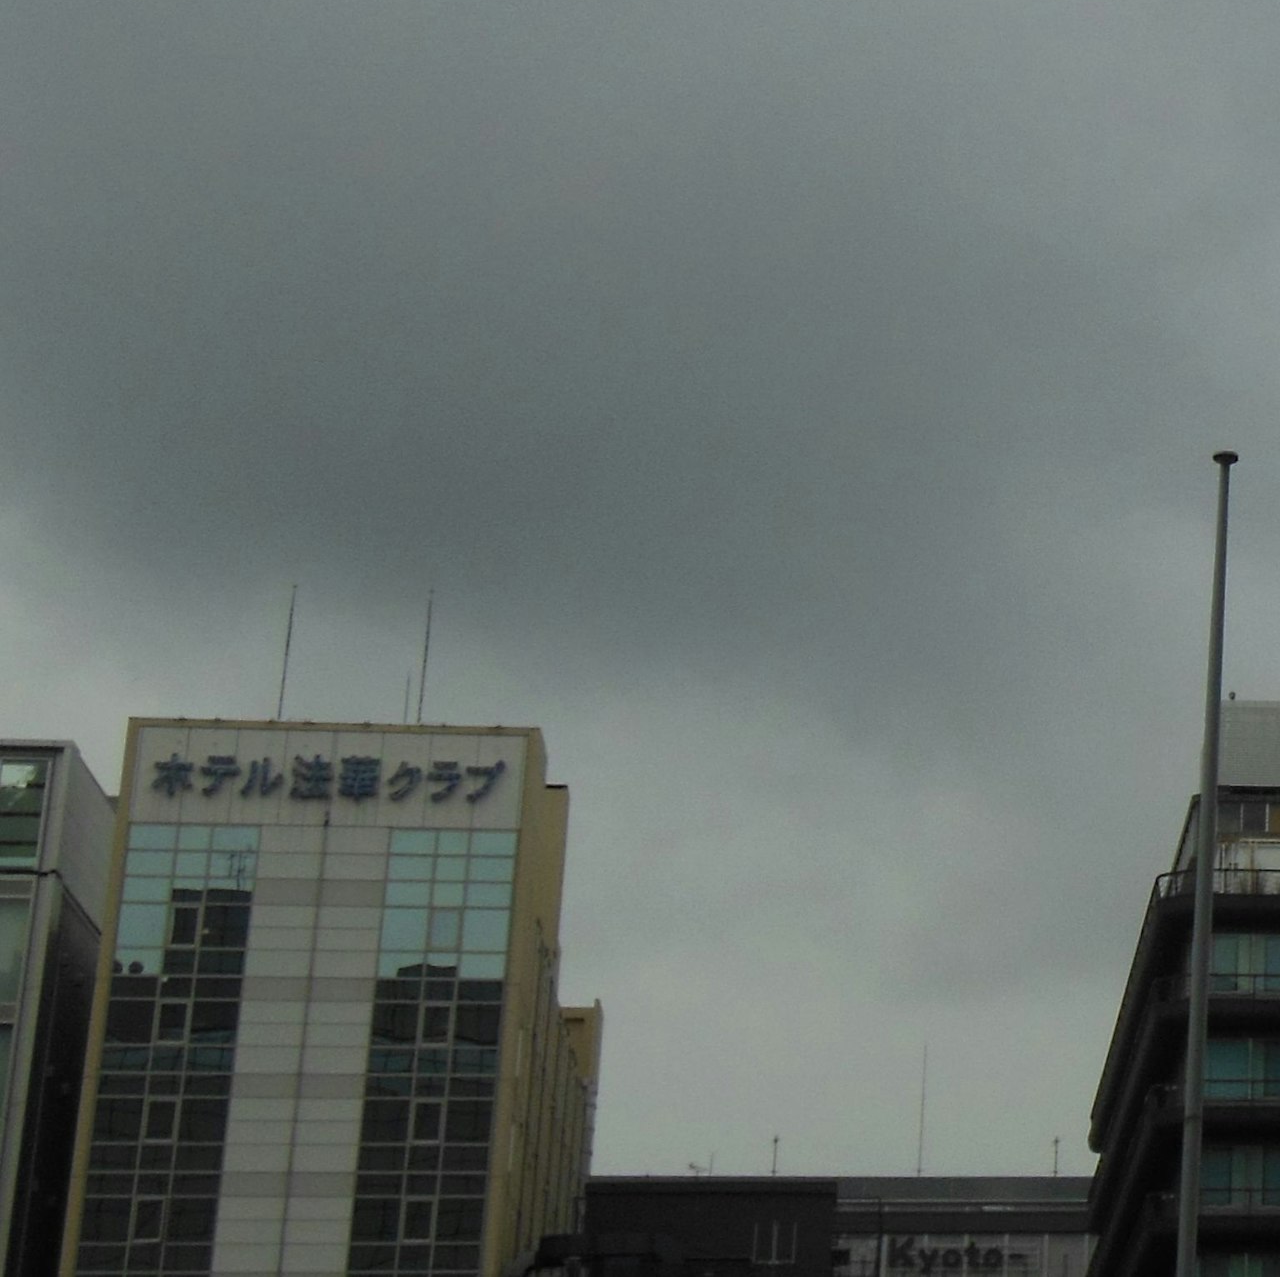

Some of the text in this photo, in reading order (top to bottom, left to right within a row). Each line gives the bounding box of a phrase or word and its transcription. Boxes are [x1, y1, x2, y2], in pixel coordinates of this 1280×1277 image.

[152, 752, 506, 804] ホテル法華クラブ
